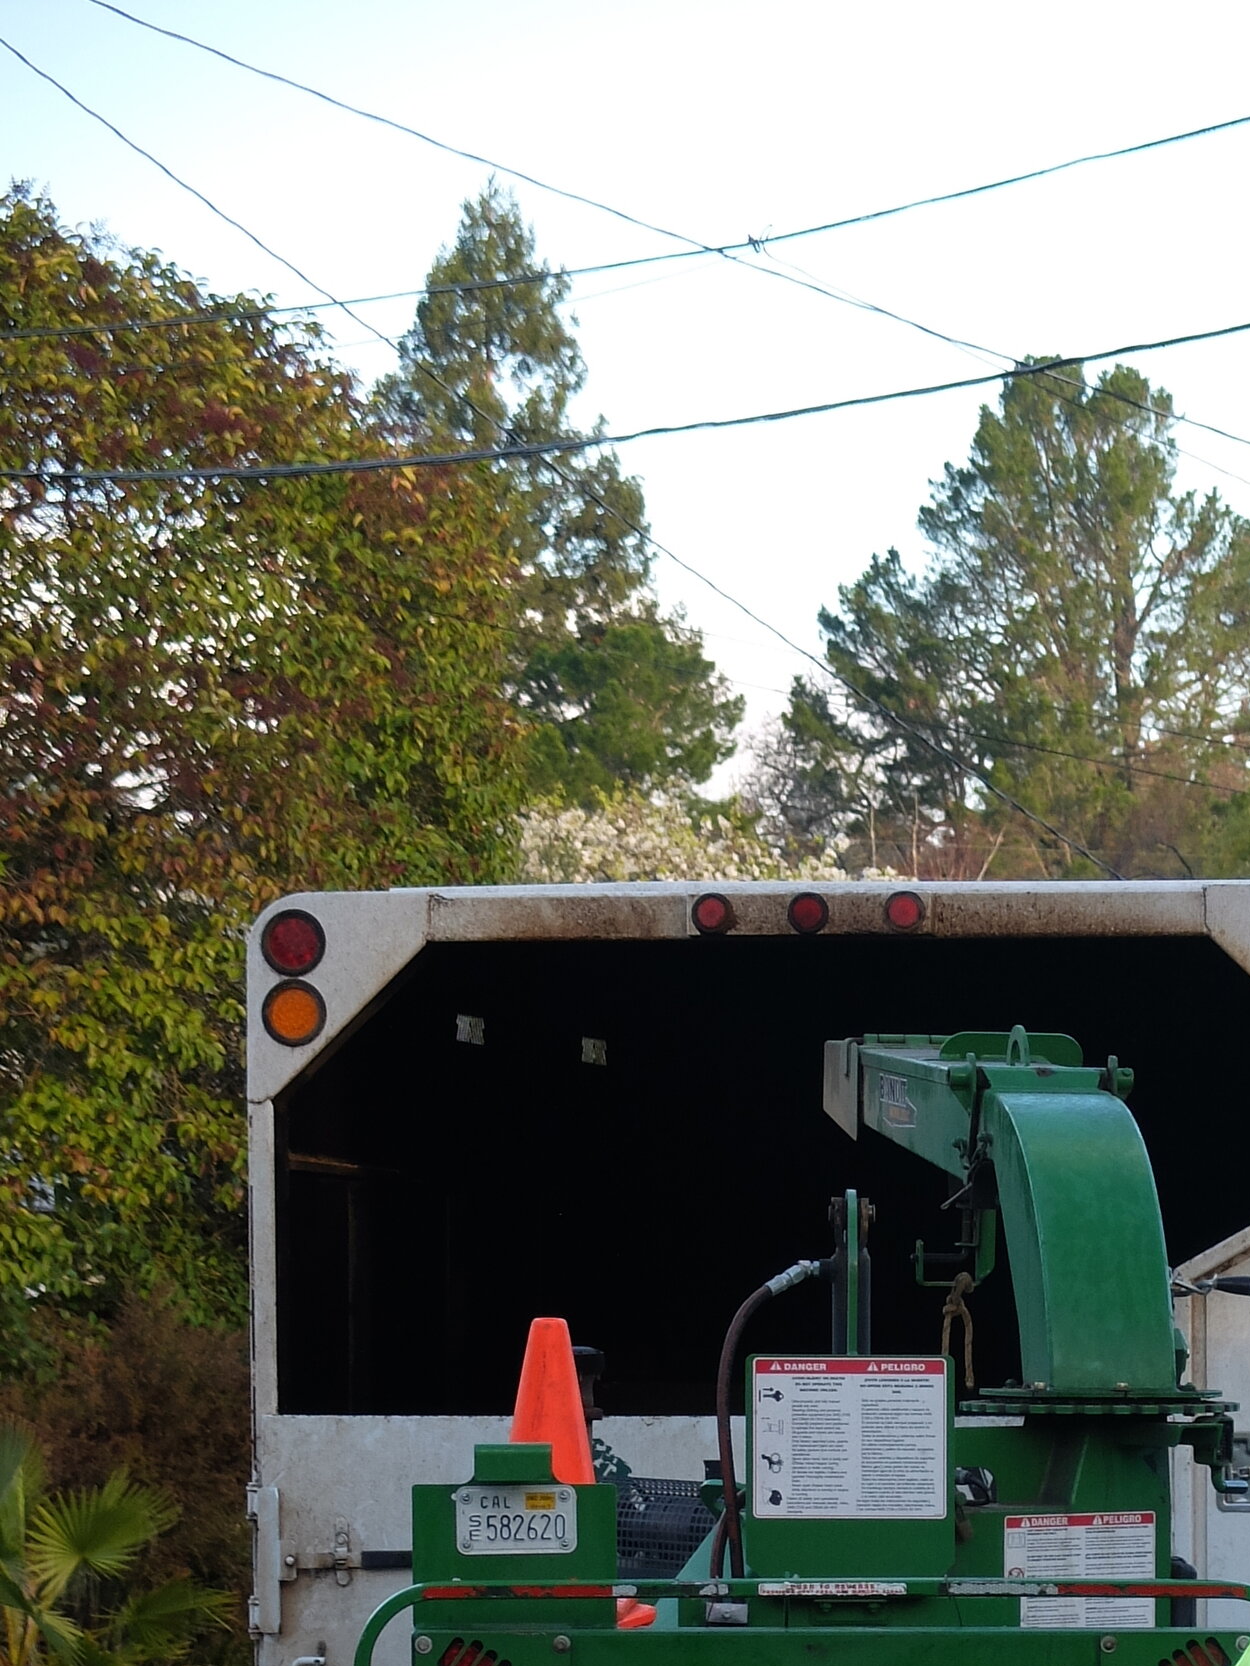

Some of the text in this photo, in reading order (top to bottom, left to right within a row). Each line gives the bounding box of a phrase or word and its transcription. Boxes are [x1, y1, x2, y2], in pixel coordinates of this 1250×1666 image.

[783, 1363, 827, 1372] DANGER
[881, 1363, 926, 1372] PELIGRO
[480, 1495, 511, 1509] CAL
[1031, 1517, 1069, 1526] DANGER
[1103, 1515, 1142, 1524] PELIGRO
[486, 1514, 566, 1542] 582620
